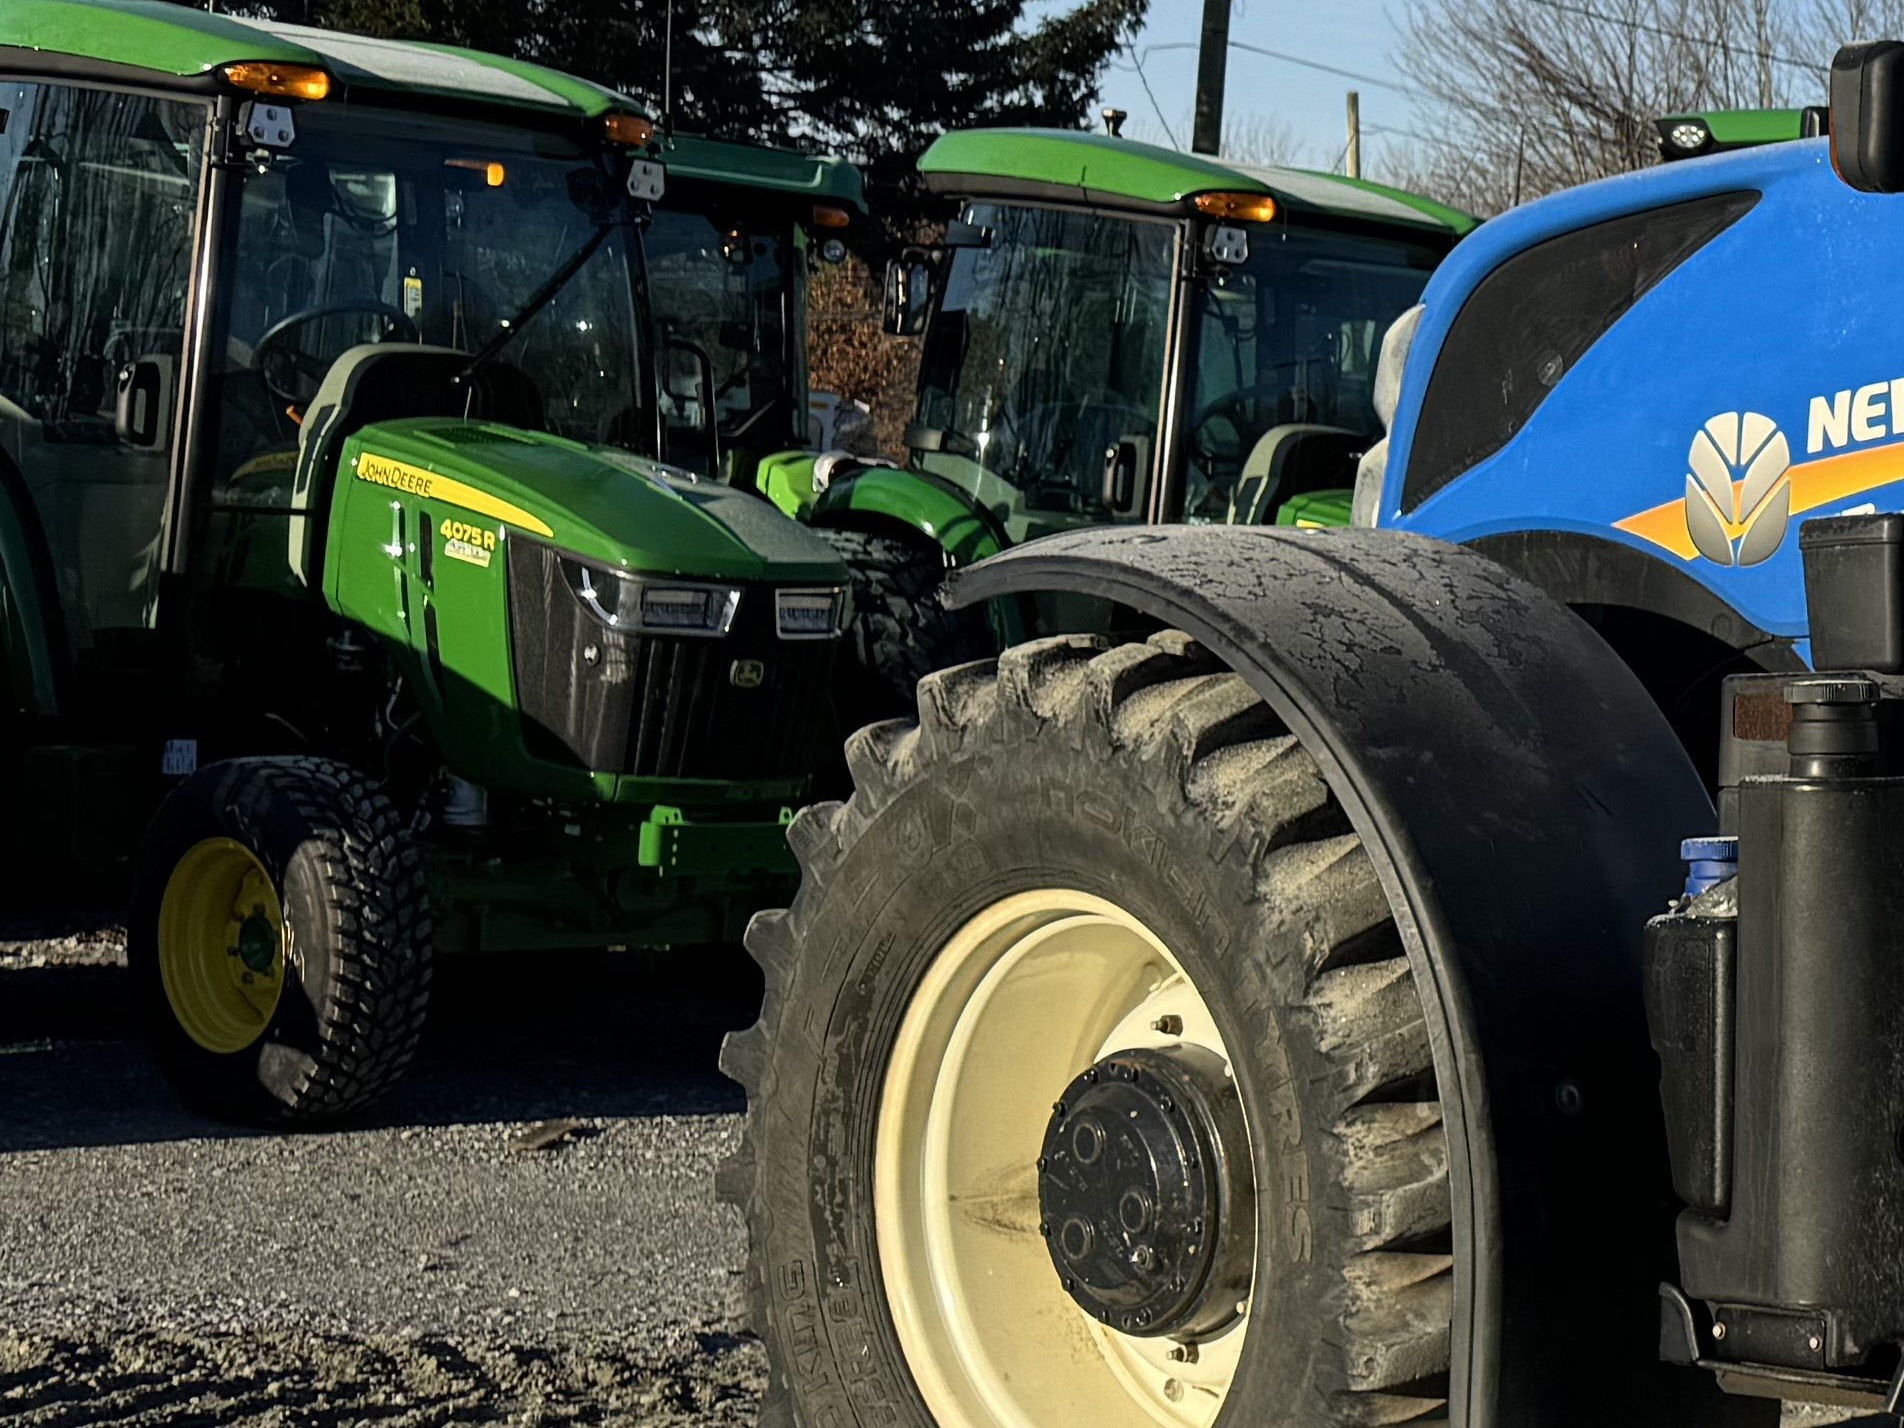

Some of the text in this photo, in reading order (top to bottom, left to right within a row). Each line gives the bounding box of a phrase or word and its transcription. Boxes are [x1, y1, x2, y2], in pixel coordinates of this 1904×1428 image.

[361, 460, 433, 495] JOHN DEERE
[440, 519, 495, 551] 4075R
[1230, 956, 1313, 1264] TYRES
